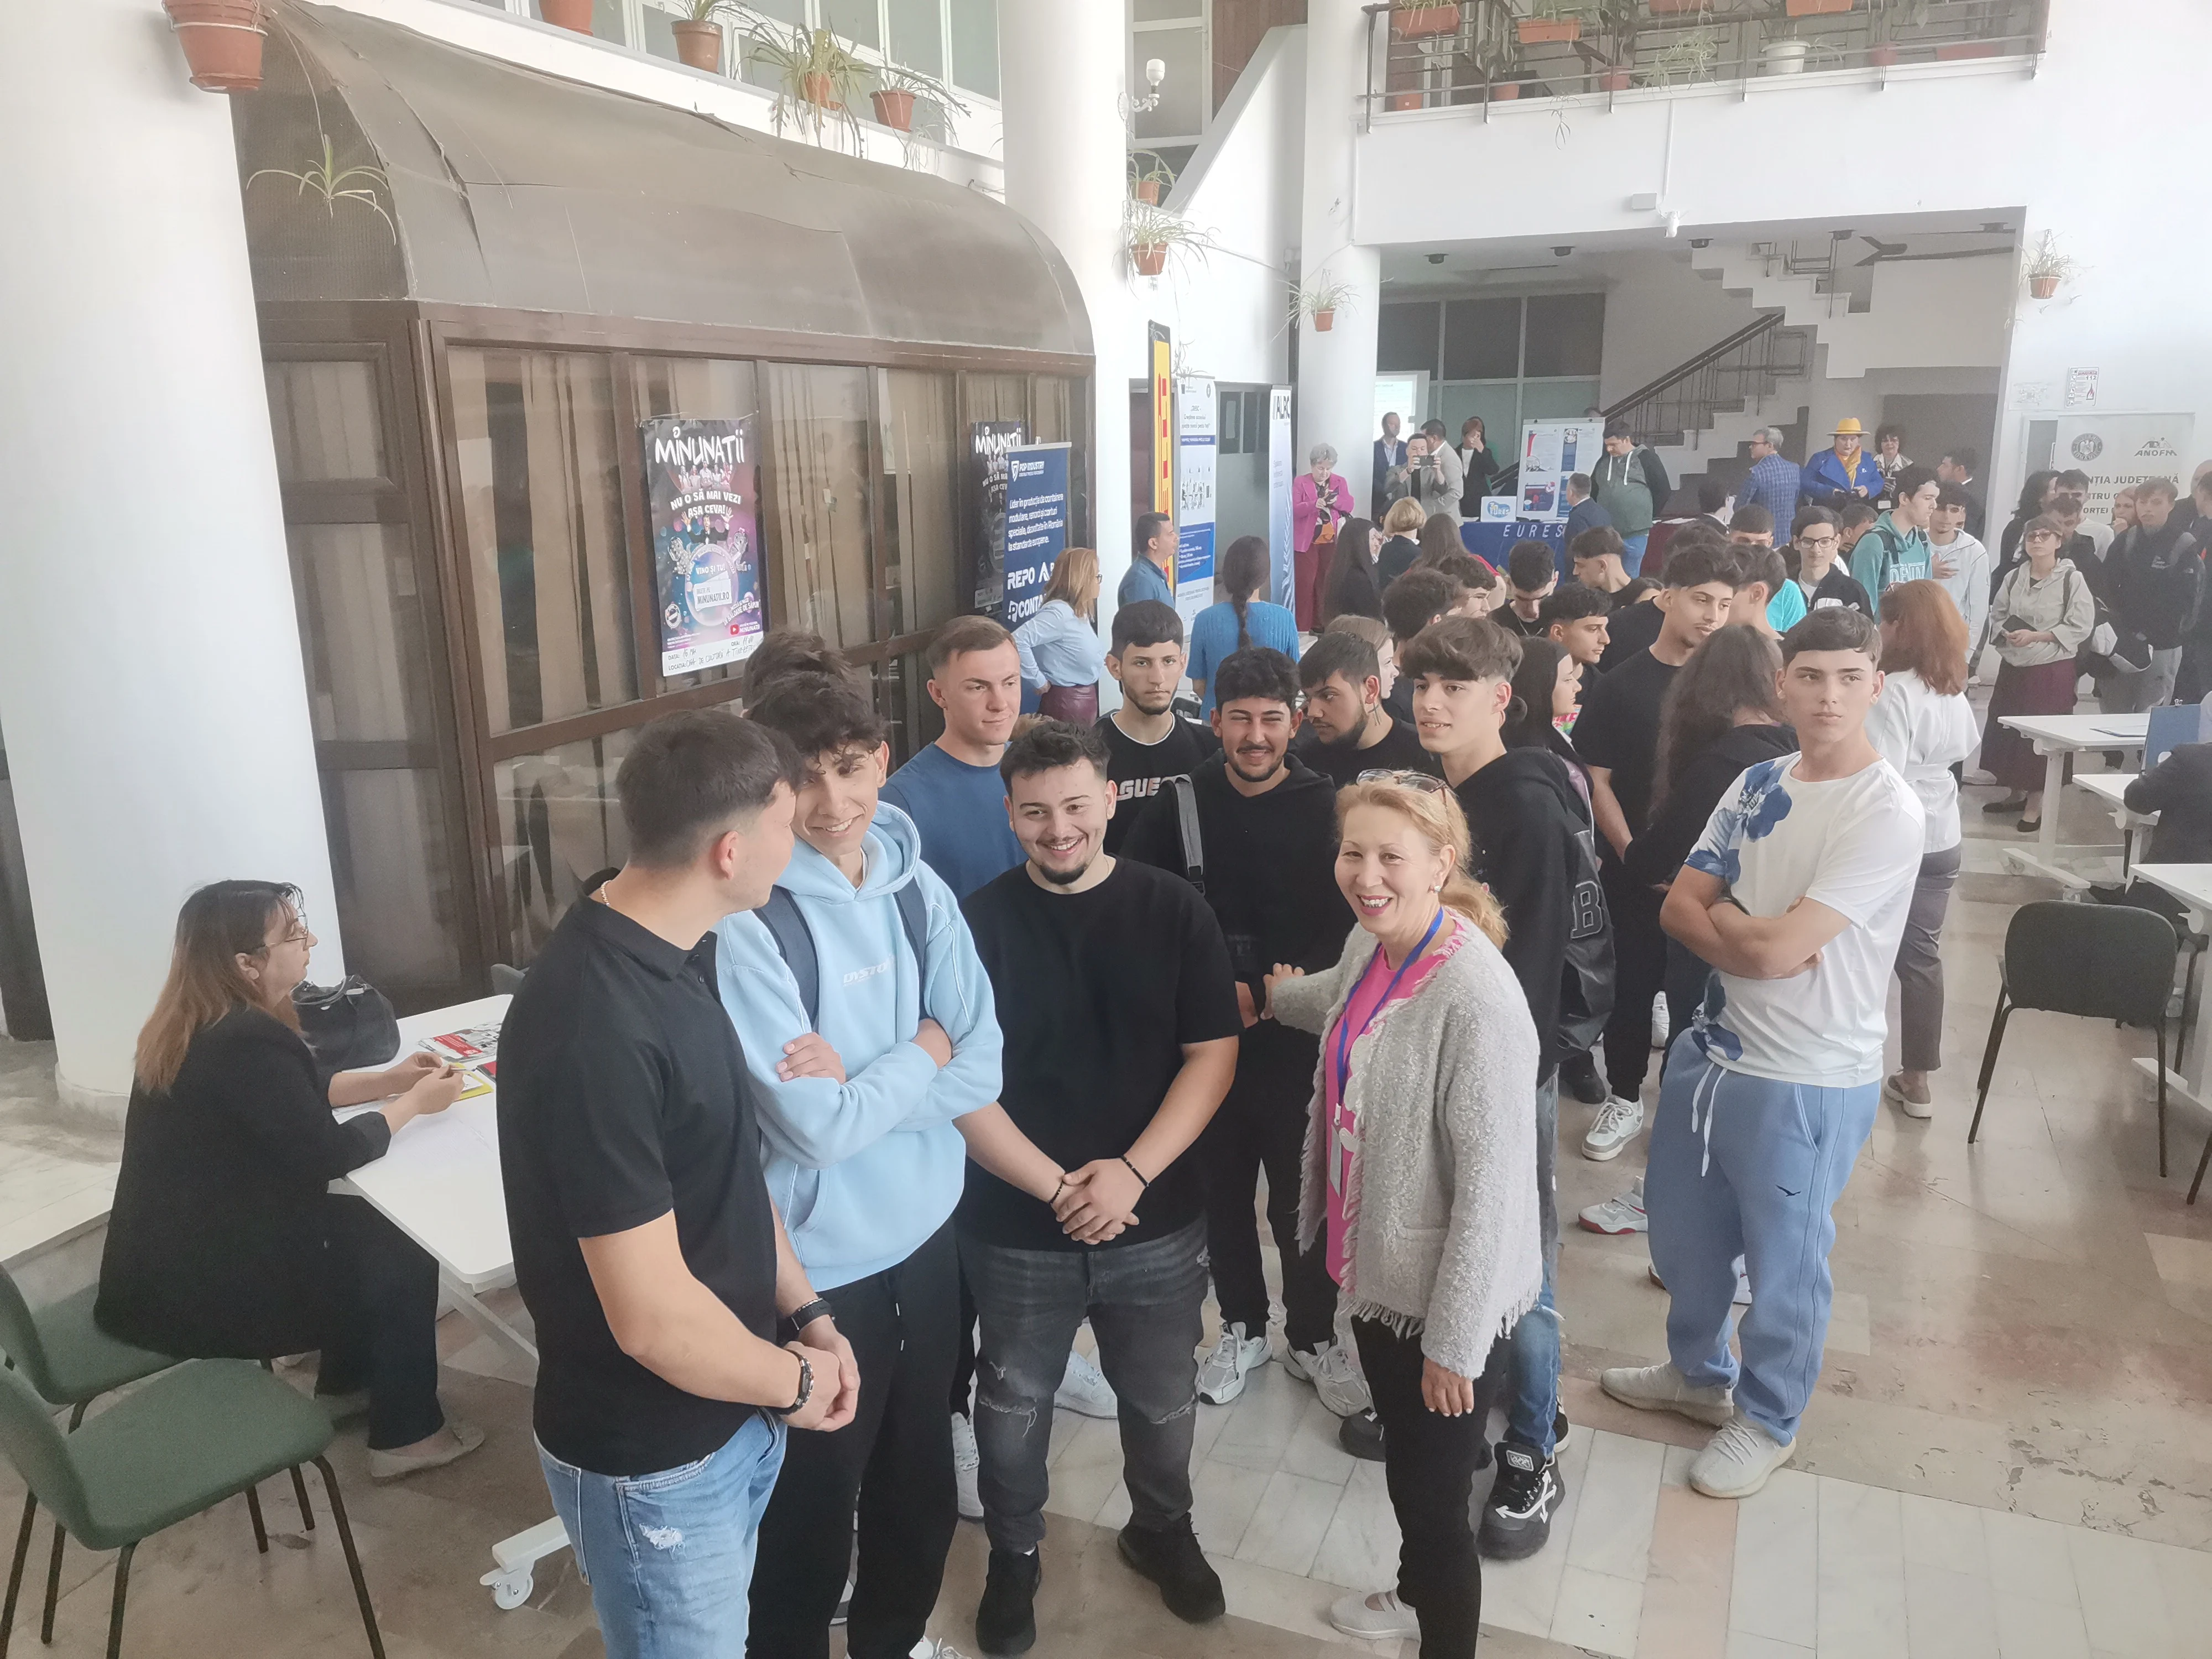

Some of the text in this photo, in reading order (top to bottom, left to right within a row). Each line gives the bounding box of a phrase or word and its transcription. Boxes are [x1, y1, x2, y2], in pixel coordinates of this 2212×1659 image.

[2090, 476, 2111, 486] NȚIA
[670, 488, 742, 510] NU O SĂ MAI VEZI
[1010, 499, 1019, 509] Lider
[1040, 495, 1045, 504] de
[1045, 493, 1063, 503] containere
[688, 504, 726, 519] AȘA CEVA!
[1009, 513, 1029, 523] modulare,
[1045, 506, 1057, 517] corturi
[2083, 507, 2108, 515] ORȚEI
[1503, 524, 1563, 538] EURES
[1008, 542, 1013, 552] la
[1013, 539, 1032, 551] standarde
[696, 566, 709, 575] VINO
[710, 565, 716, 575] ȘI
[717, 563, 726, 572] TU!
[1008, 567, 1035, 590] REPO
[742, 603, 748, 612] DE
[1018, 593, 1046, 618] CONTA
[1116, 776, 1162, 801] GUE
[1571, 880, 1603, 940] B
